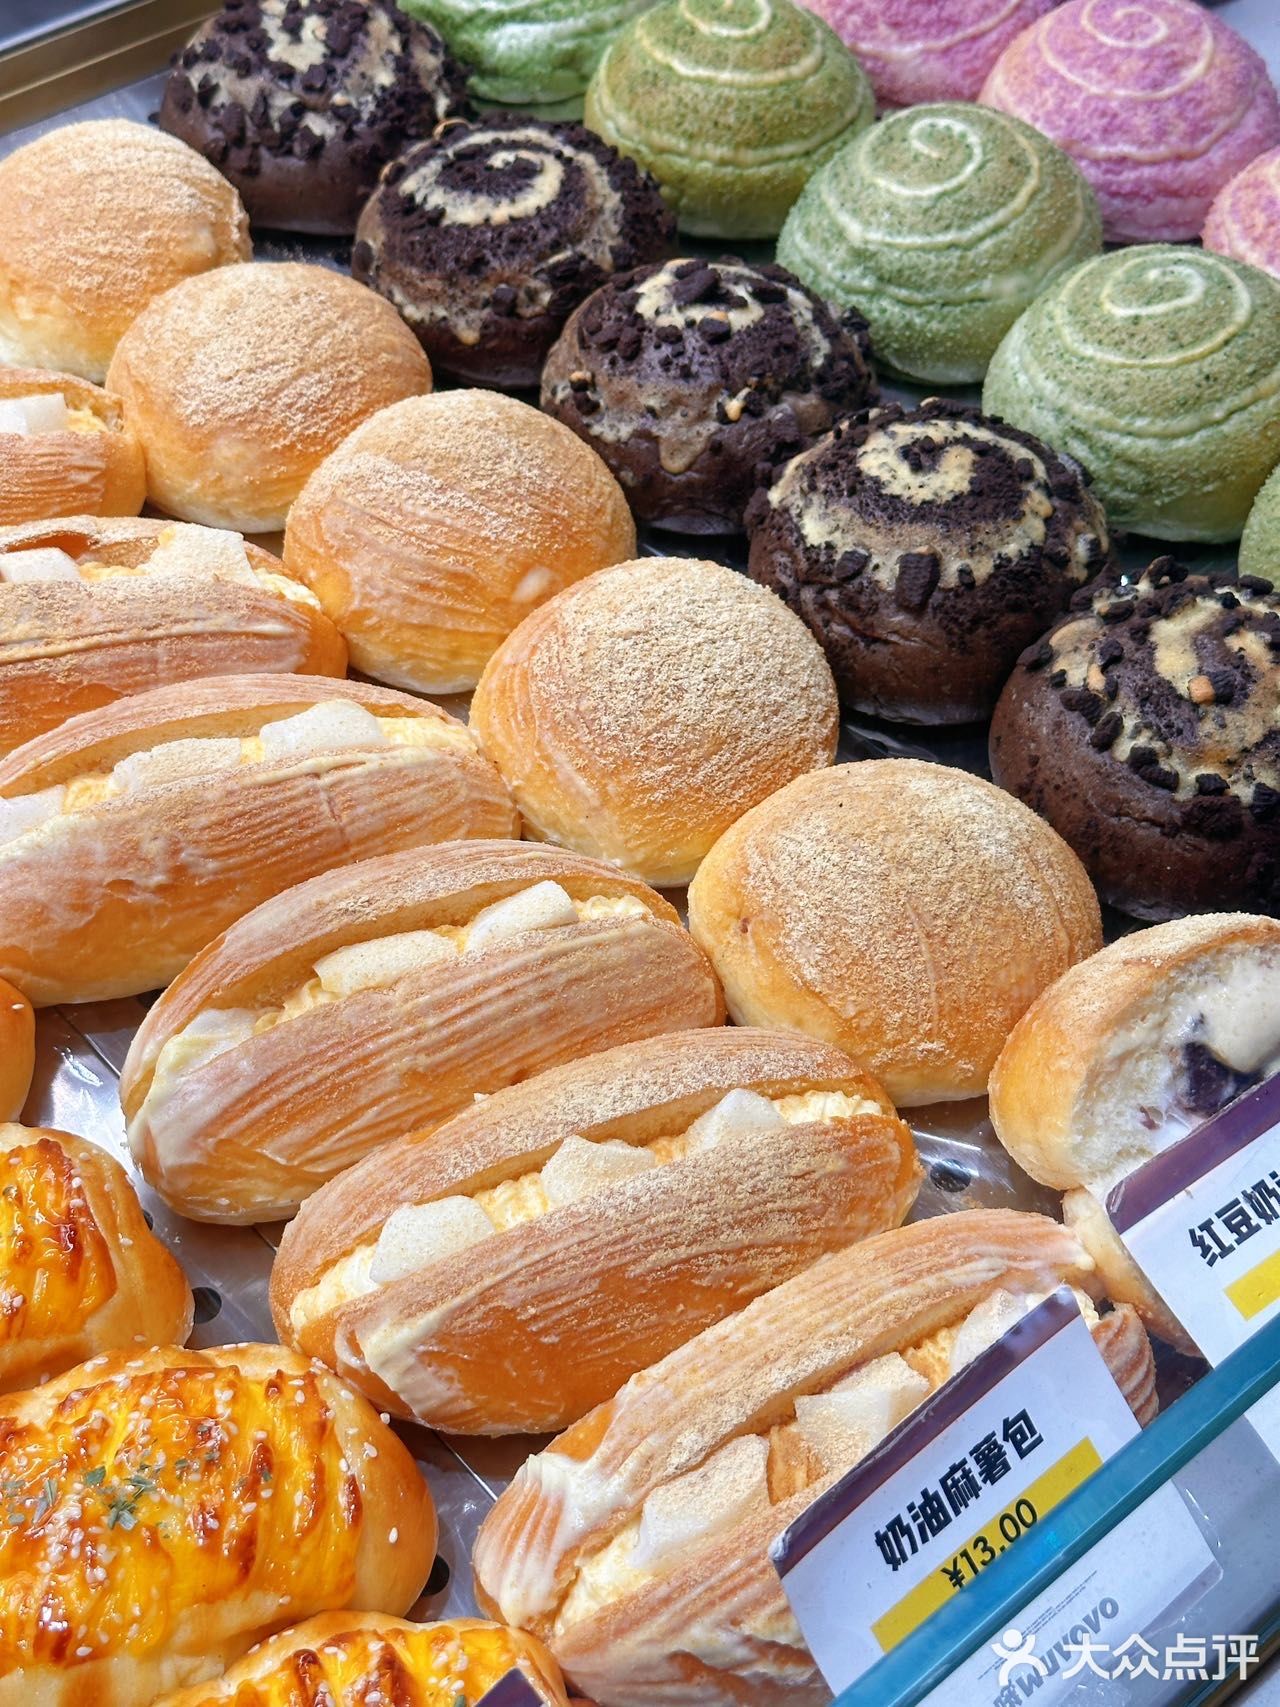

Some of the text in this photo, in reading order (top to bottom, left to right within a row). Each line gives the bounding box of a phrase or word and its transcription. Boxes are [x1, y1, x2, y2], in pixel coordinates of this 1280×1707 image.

[1188, 1170, 1280, 1267] 红豆奶
[874, 1408, 1044, 1571] 奶油麻薯包
[941, 1498, 1038, 1588] ¥13.00
